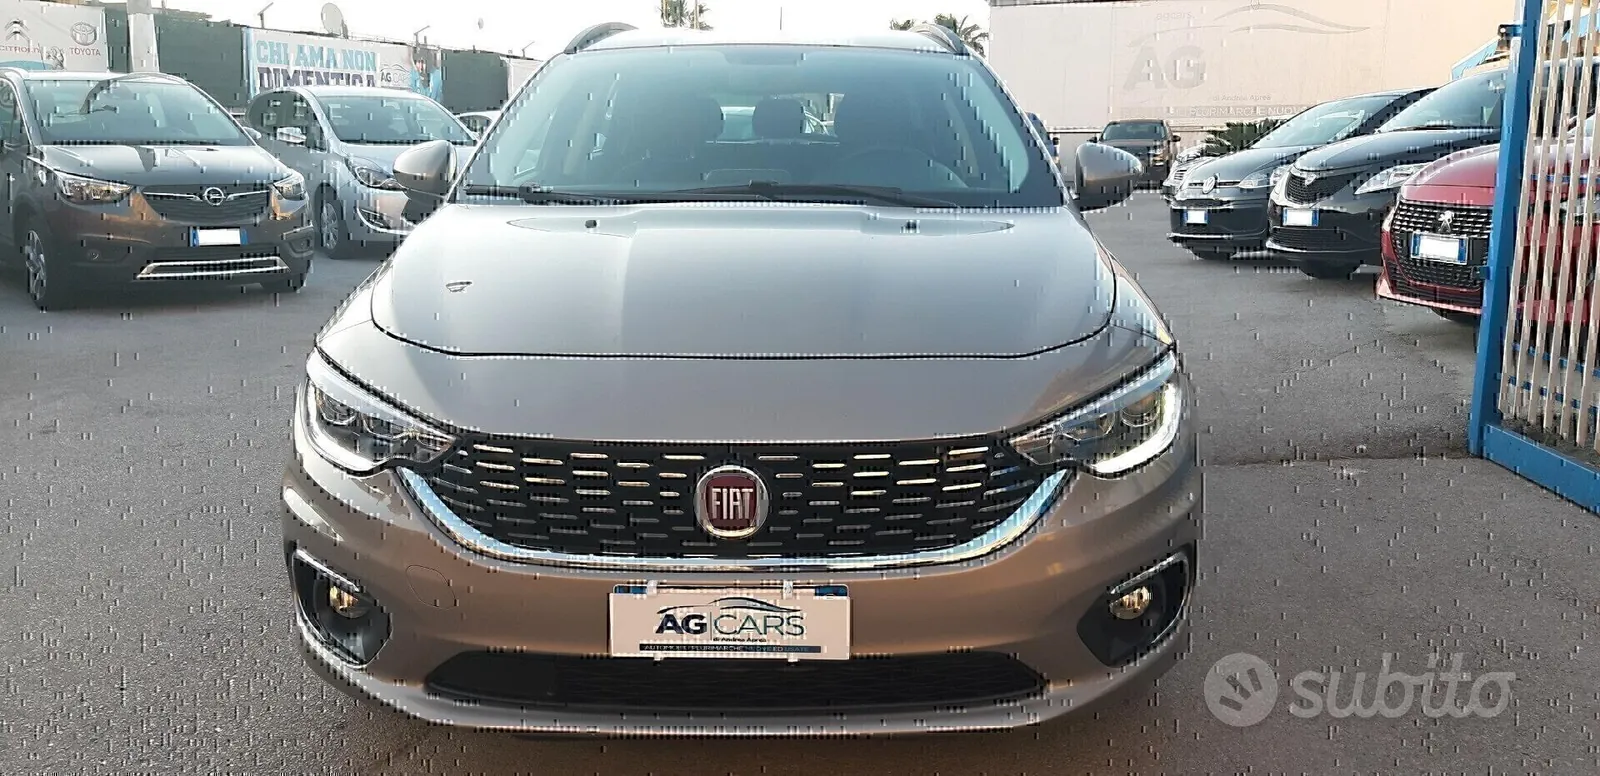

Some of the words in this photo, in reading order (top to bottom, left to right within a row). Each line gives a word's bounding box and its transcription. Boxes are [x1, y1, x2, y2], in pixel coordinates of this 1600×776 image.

[69, 47, 101, 56] TOYOTA
[256, 40, 290, 65] CHI
[295, 44, 338, 69] AMA
[341, 49, 376, 71] NON
[380, 72, 392, 82] AG
[1122, 46, 1206, 90] AG
[711, 488, 754, 520] FIAT
[655, 614, 707, 634] AG
[713, 614, 805, 636] CARS
